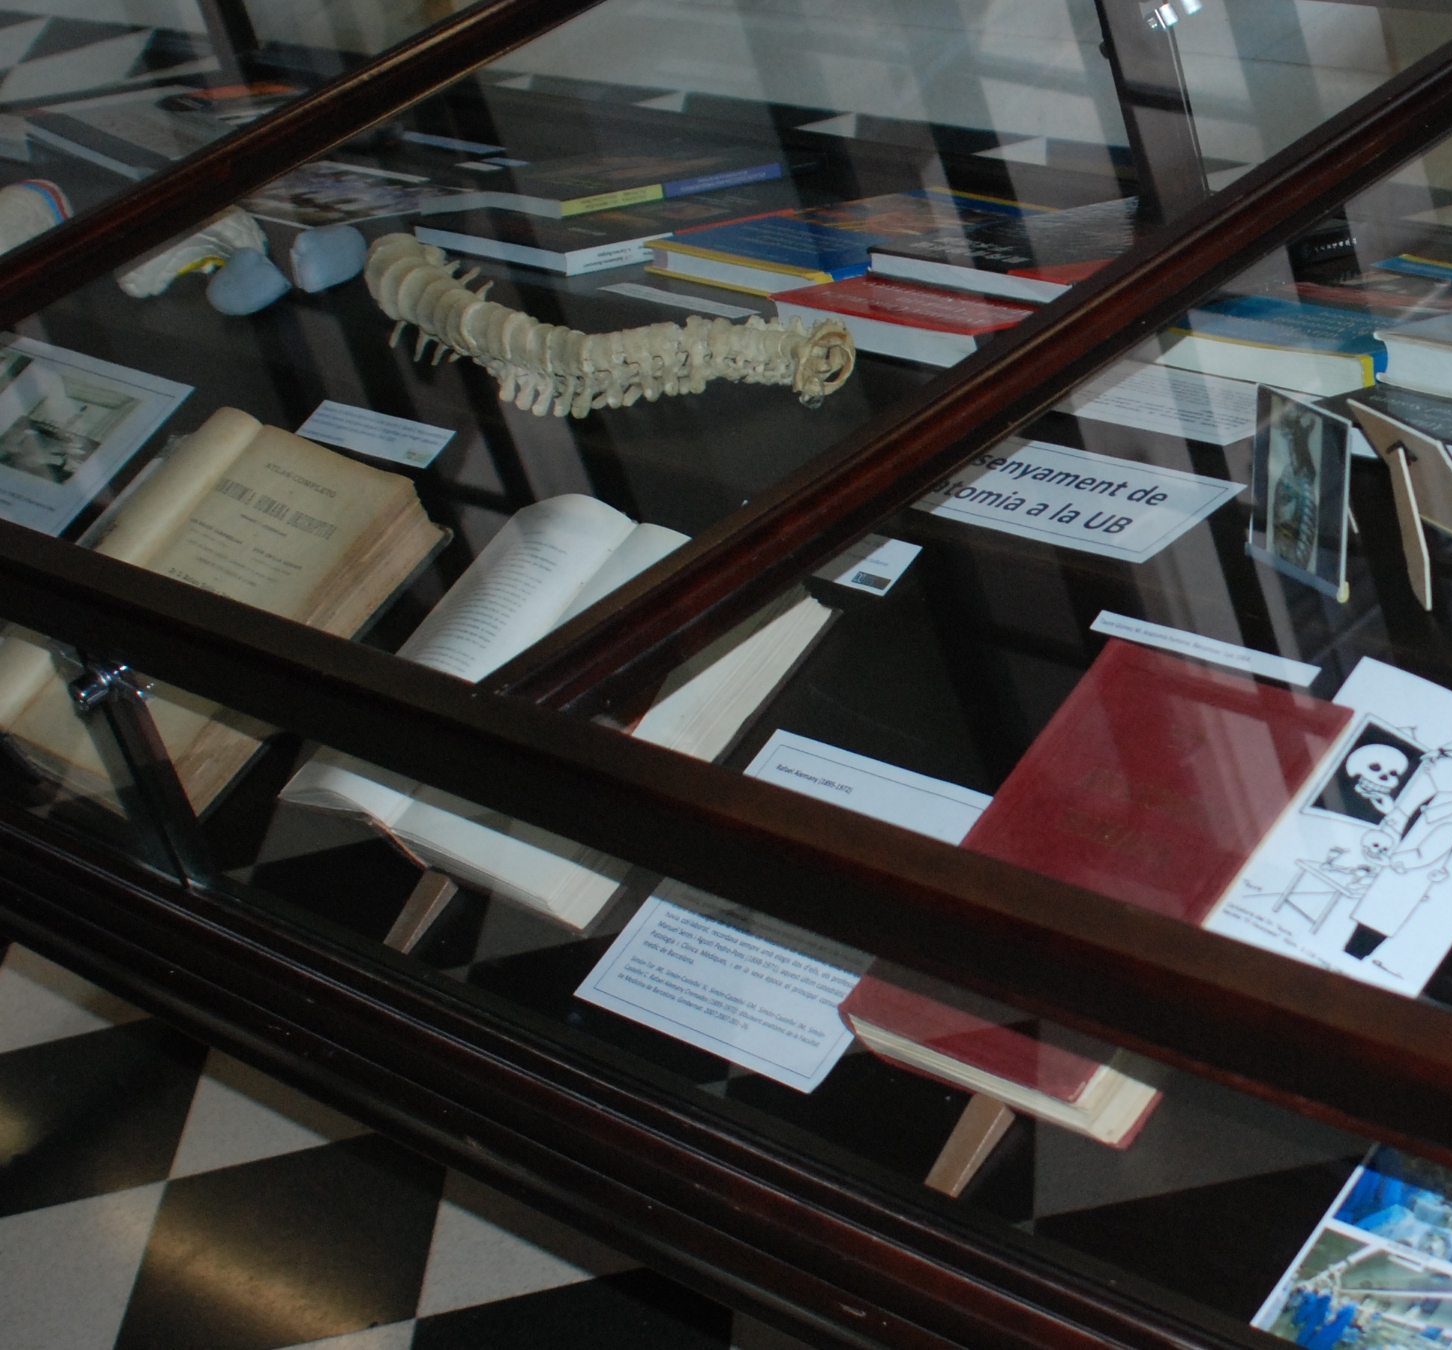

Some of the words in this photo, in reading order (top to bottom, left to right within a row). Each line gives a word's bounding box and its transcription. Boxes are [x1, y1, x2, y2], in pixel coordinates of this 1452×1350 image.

[1127, 486, 1168, 507] de
[1026, 500, 1049, 517] a
[1050, 503, 1081, 525] la
[1083, 512, 1133, 534] UB
